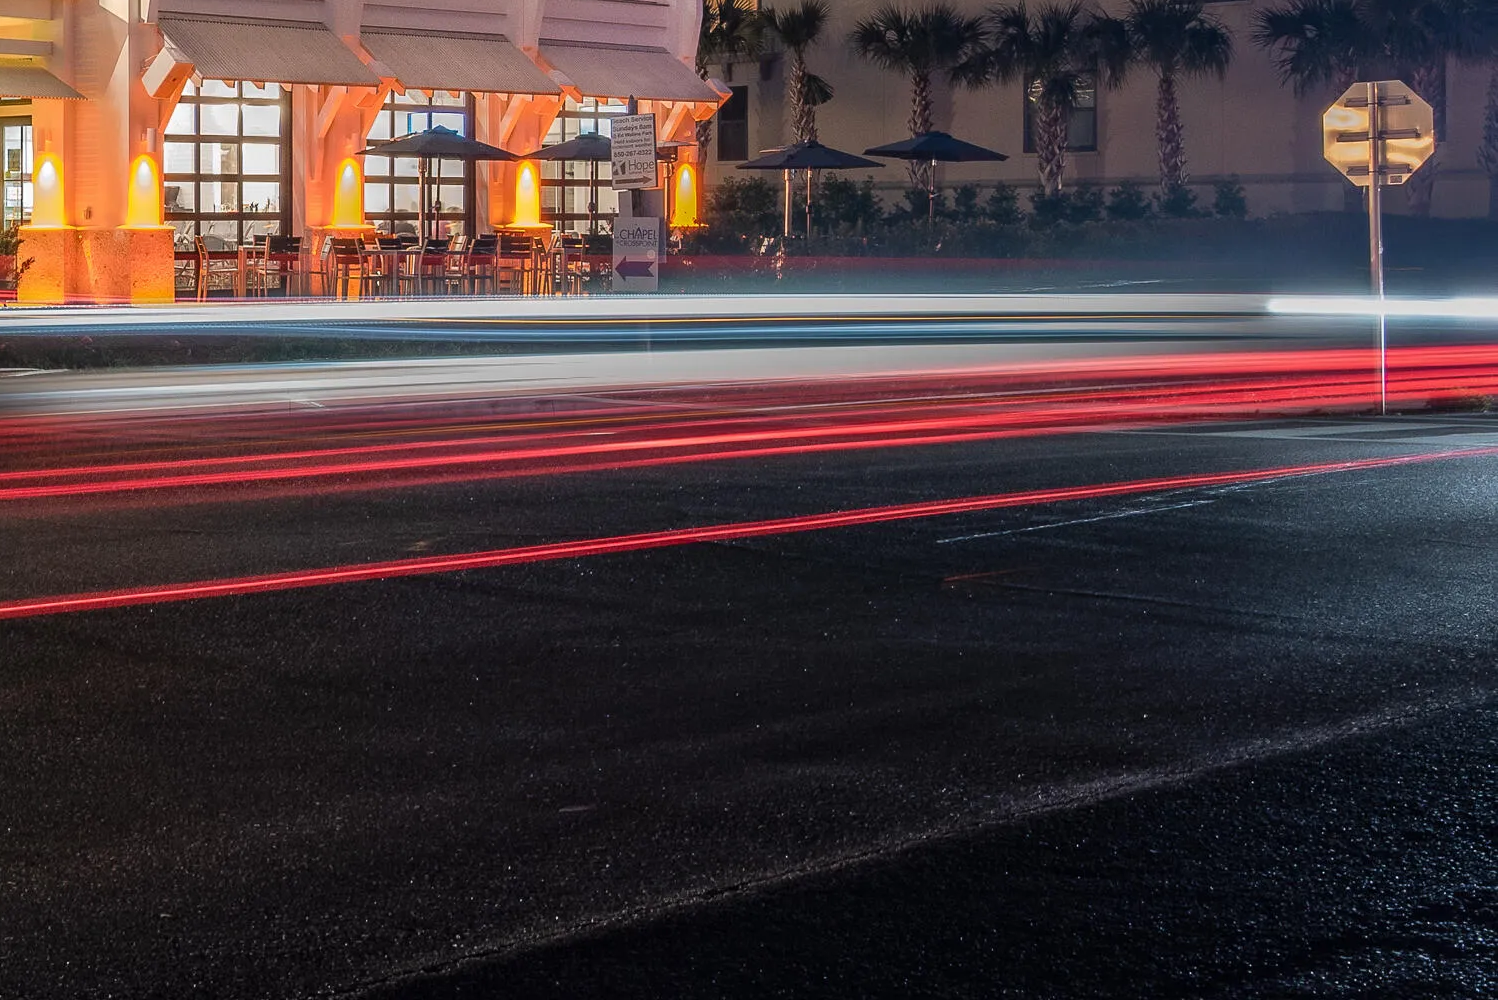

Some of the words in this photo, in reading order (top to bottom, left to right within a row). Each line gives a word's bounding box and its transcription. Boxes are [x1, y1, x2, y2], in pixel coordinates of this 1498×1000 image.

[631, 115, 653, 123] Service
[628, 160, 654, 172] Hope
[620, 227, 658, 240] CHAPEL
